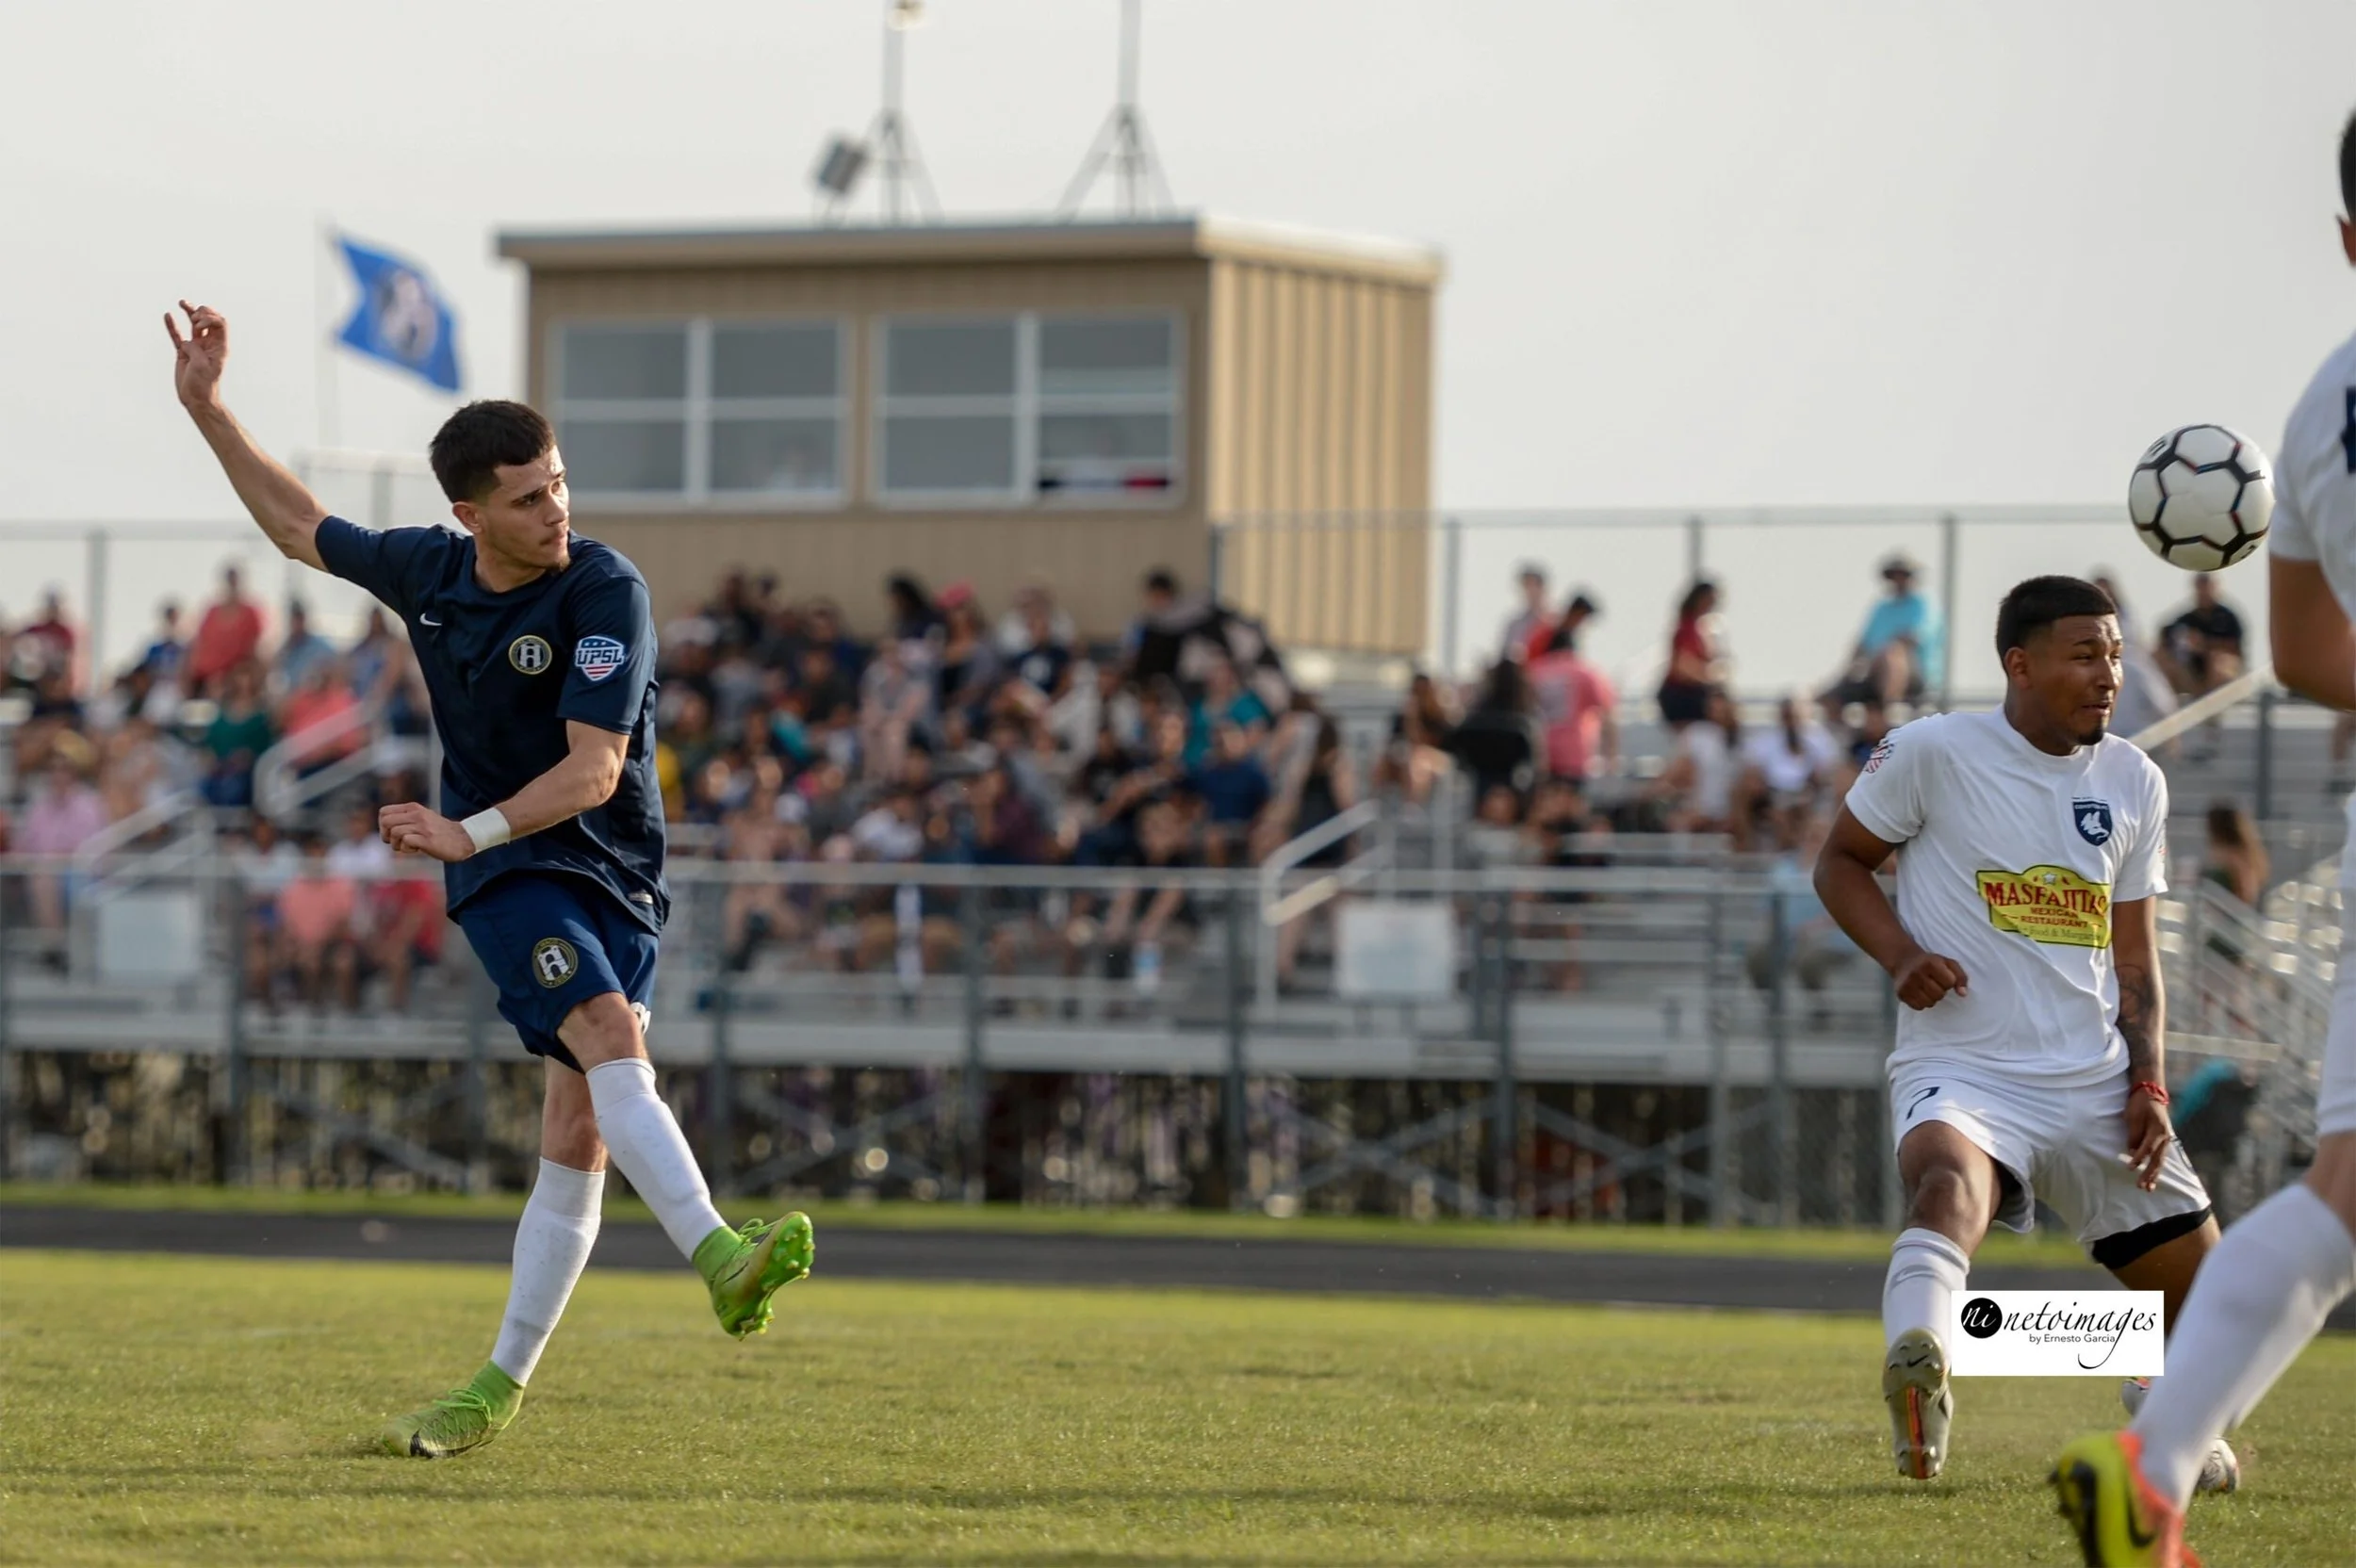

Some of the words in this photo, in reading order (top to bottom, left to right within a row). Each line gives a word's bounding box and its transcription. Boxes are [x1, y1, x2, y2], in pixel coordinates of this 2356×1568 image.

[577, 649, 622, 664] UPSL
[2030, 907, 2079, 919] MEXICAN
[2021, 916, 2088, 928] RESTAURANT
